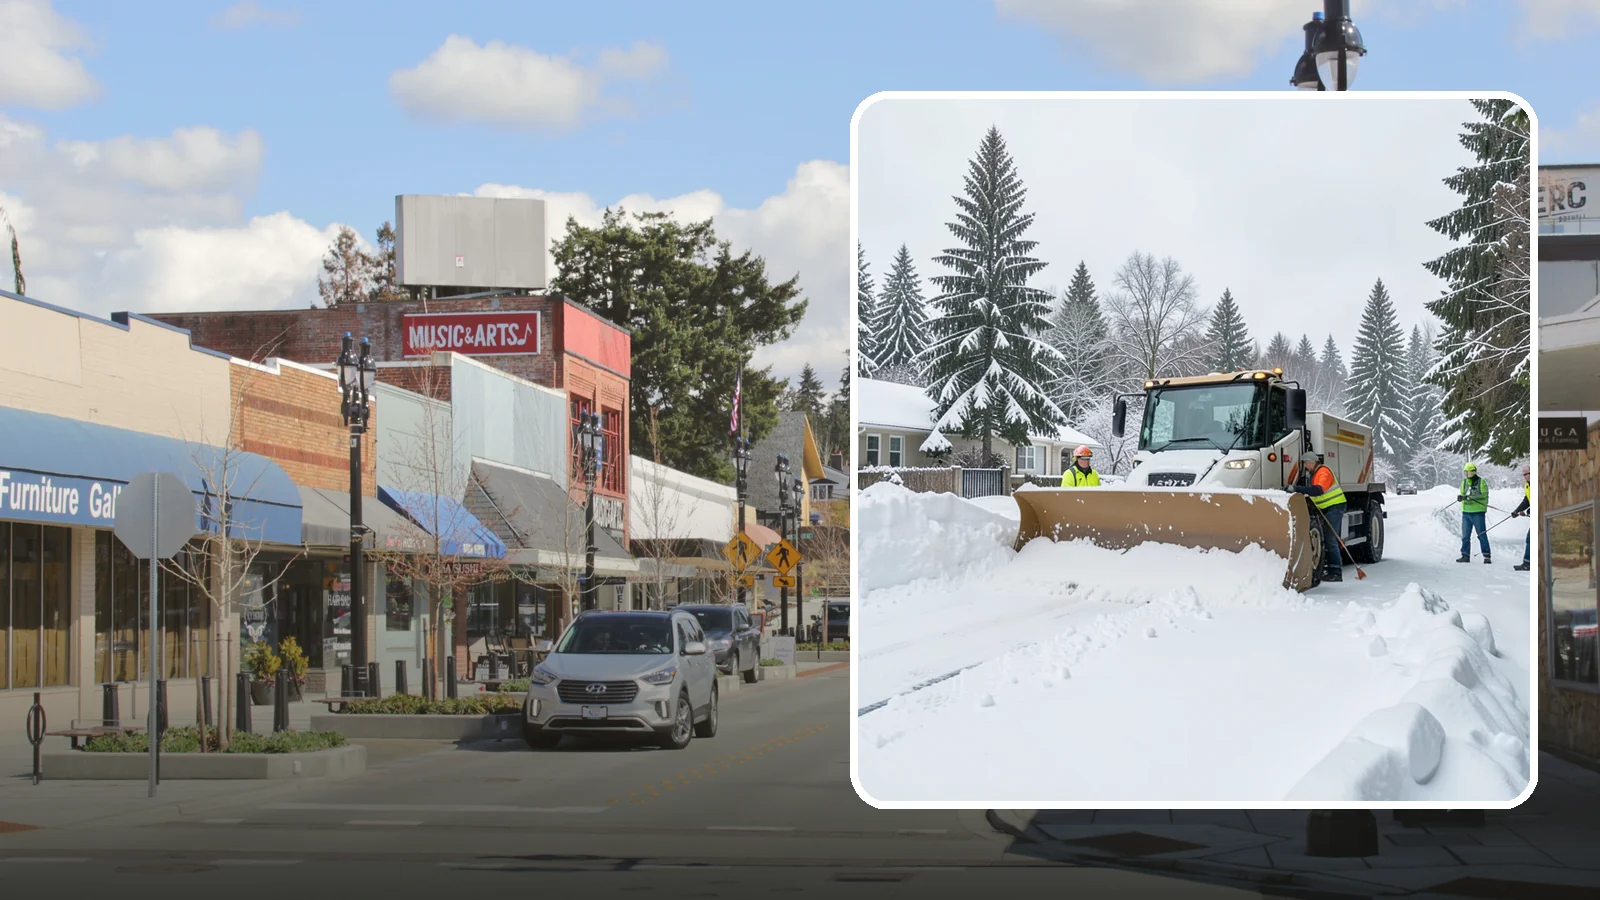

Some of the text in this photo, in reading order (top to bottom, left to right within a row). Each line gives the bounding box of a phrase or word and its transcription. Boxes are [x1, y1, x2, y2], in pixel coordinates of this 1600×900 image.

[1540, 427, 1577, 436] UGA
[0, 472, 122, 519] Furniture Gal
